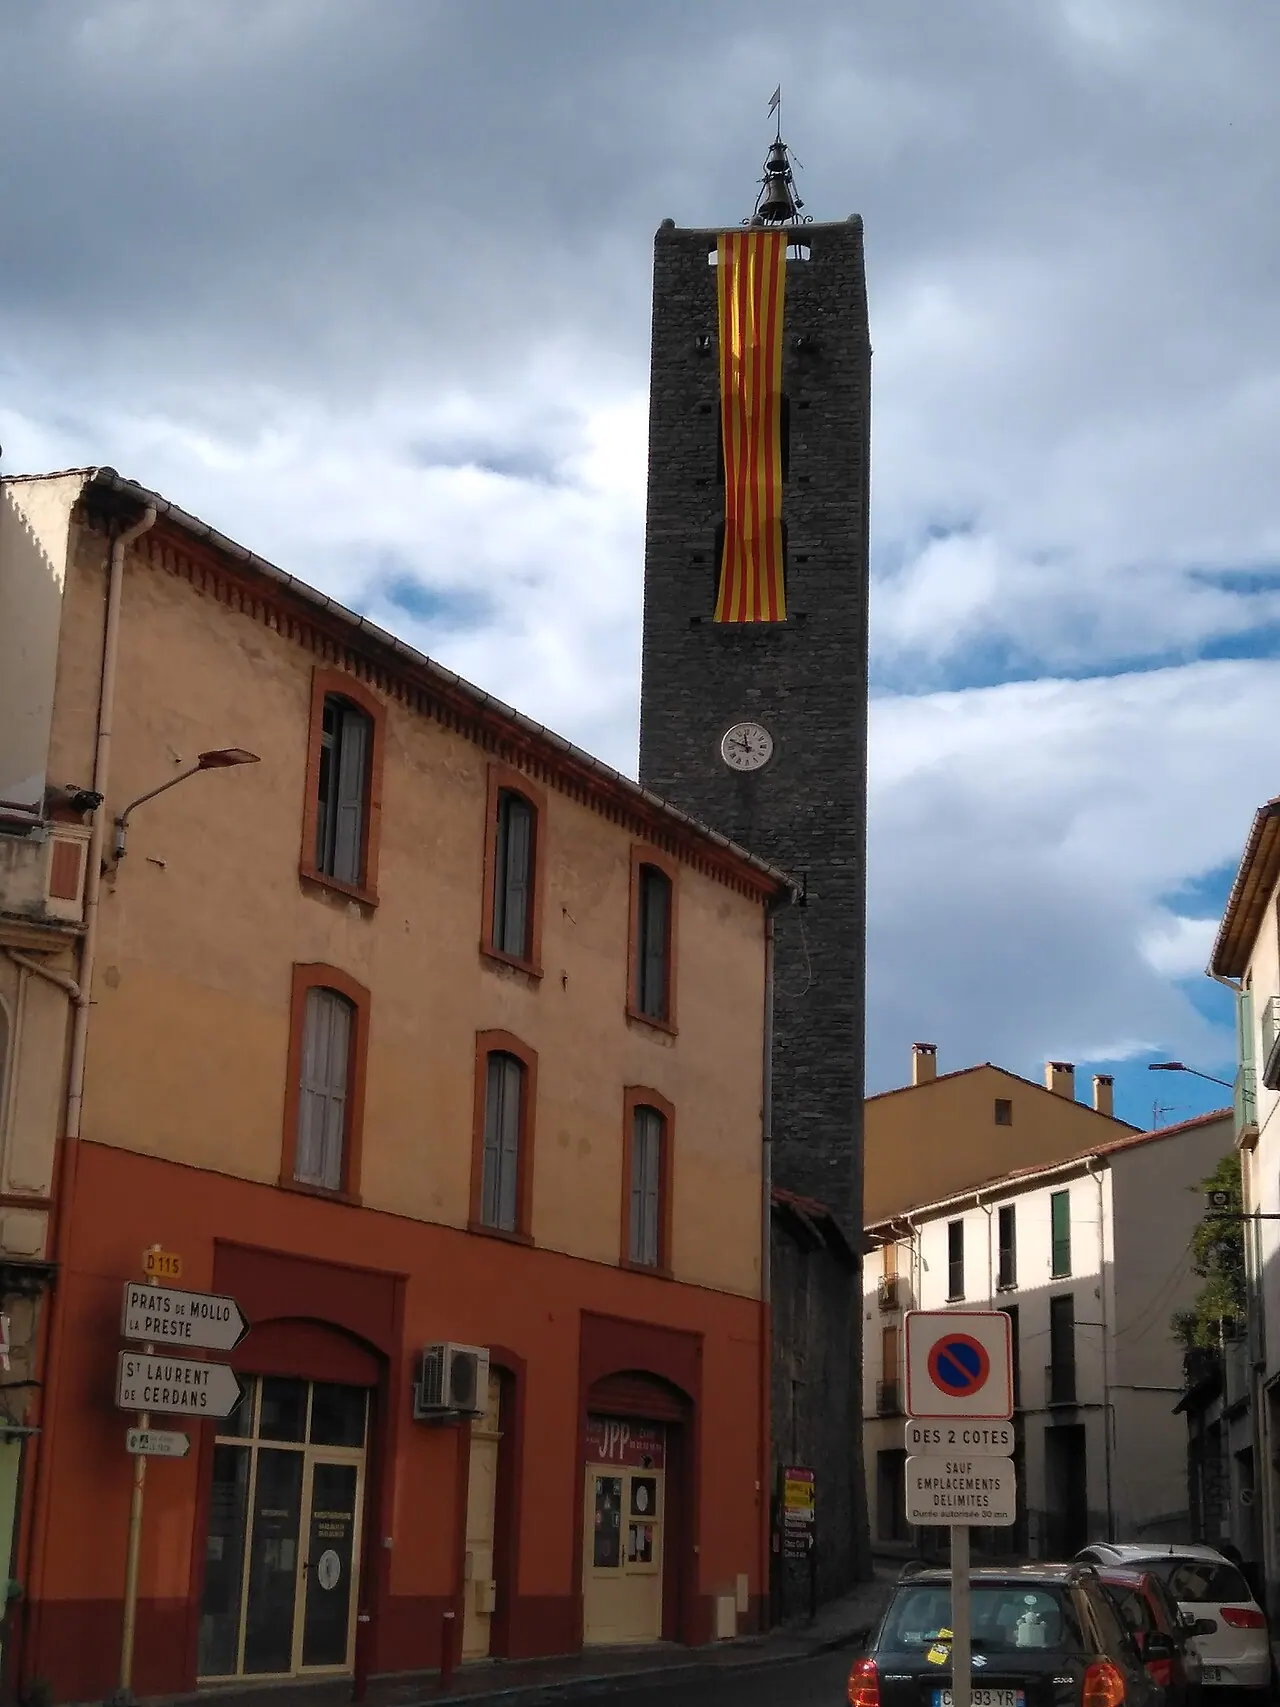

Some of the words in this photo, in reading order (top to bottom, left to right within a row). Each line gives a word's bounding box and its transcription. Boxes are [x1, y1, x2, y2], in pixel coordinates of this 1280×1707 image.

[147, 1254, 155, 1269] D
[159, 1257, 180, 1274] 115
[131, 1292, 171, 1313] PRATS
[175, 1303, 185, 1315] DE
[190, 1301, 230, 1322] MOLLO
[129, 1319, 139, 1331] LA
[145, 1316, 192, 1338] PRESTE
[147, 1363, 210, 1386] LAURENT
[124, 1389, 136, 1401] DE
[143, 1386, 207, 1407] CERDANS
[913, 1429, 941, 1444] DES
[947, 1430, 956, 1444] 2
[963, 1430, 1009, 1445] COTES
[945, 1462, 973, 1474] SAUF
[917, 1478, 1001, 1490] EMPLACEMENTS
[933, 1494, 989, 1507] DELIMITES
[981, 1510, 992, 1518] 30
